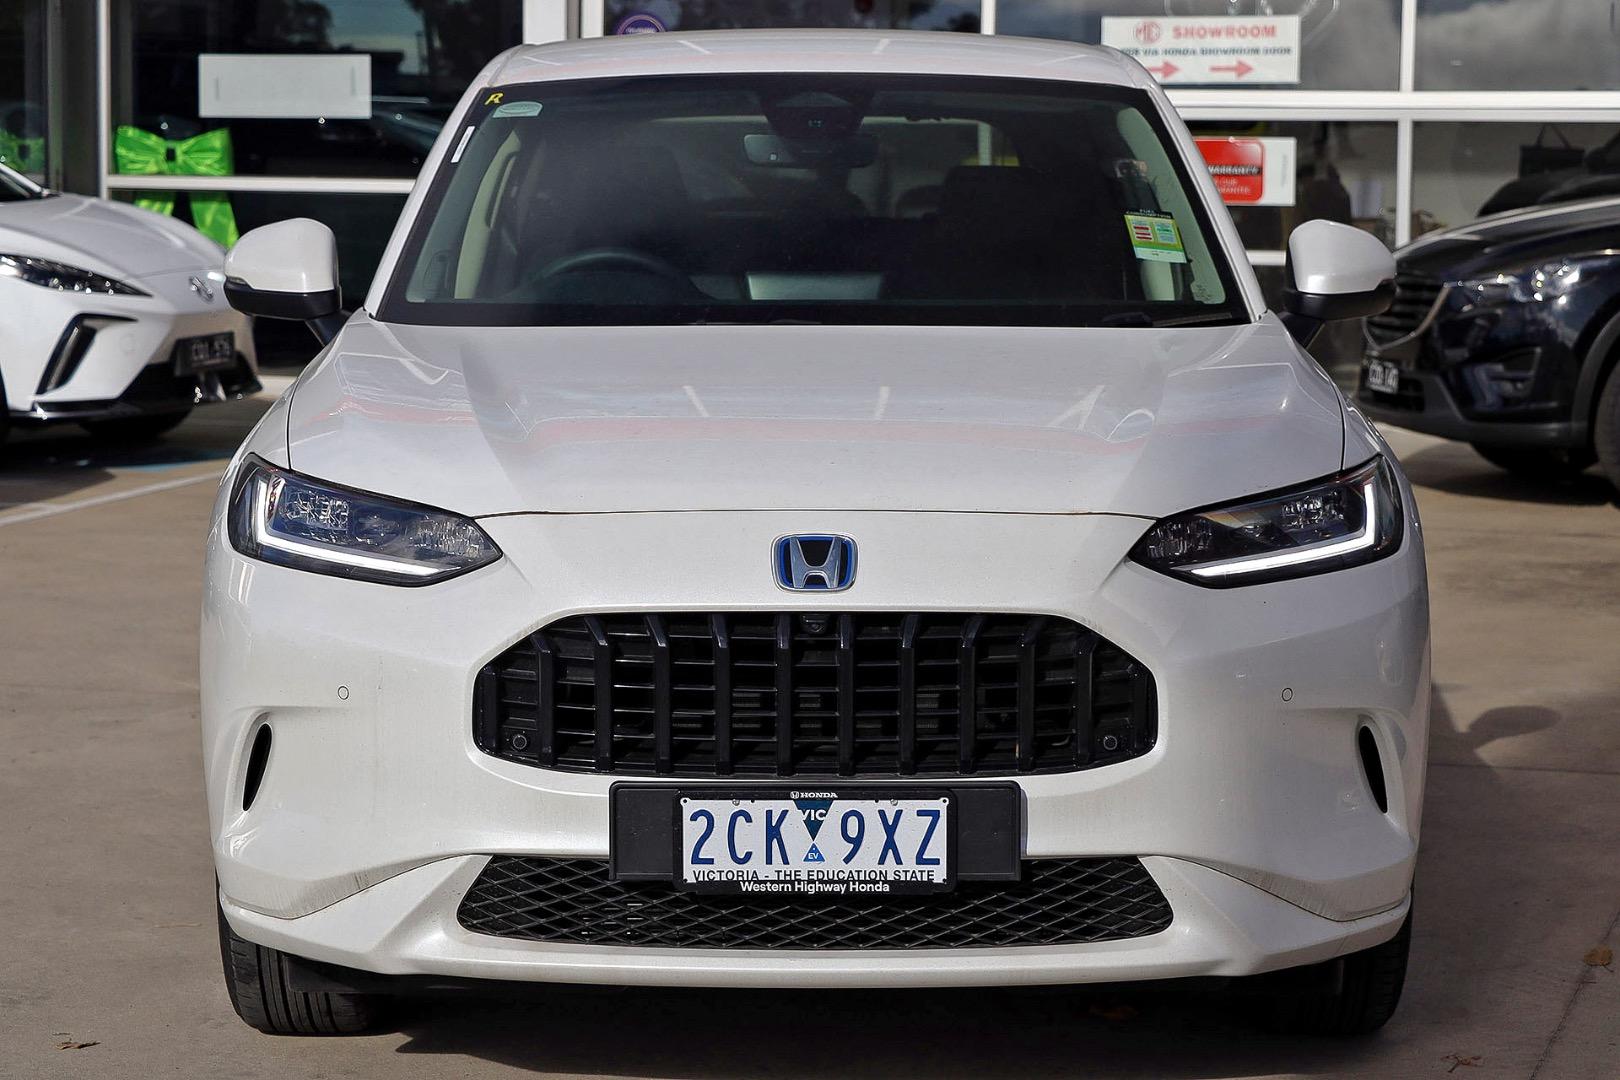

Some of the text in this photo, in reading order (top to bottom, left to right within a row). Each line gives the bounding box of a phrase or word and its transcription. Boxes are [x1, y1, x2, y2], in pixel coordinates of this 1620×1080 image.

[1172, 25, 1277, 40] SHOWROOM
[798, 809, 826, 821] VIC
[689, 809, 941, 865] 2CK 9XZ
[808, 852, 819, 860] EV
[692, 870, 760, 880] VICTORIA
[774, 870, 801, 880] THE
[807, 870, 888, 880] EDUCATION
[893, 870, 935, 880] STATE
[739, 881, 890, 894] Western Highway Honda
